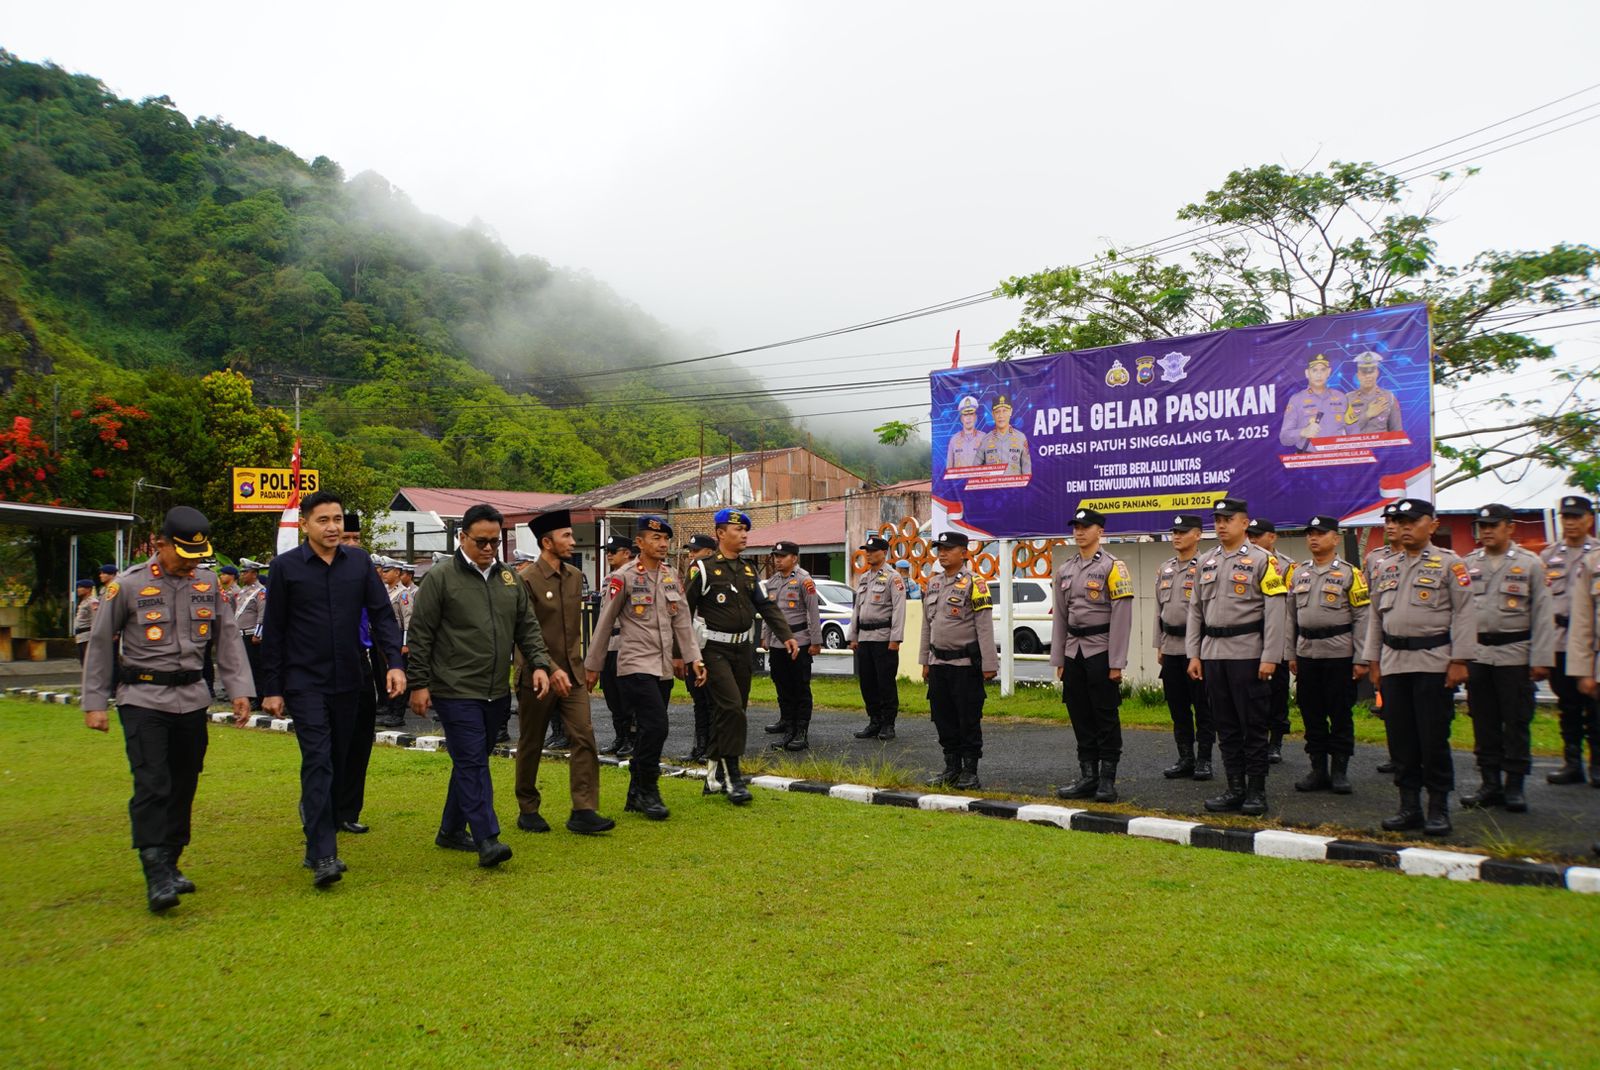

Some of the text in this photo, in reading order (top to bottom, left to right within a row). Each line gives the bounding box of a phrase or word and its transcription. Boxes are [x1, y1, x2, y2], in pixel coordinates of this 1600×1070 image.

[1033, 383, 1276, 436] APEL GELAR PASUKAN
[1038, 425, 1269, 457] OPERASI PATUH SINGGALANG TA. 2025
[1093, 457, 1202, 477] “TERTIB BERLALU LINTAS
[260, 473, 317, 491] POLRES
[1066, 468, 1235, 493] DEMI TERWUJUDNYA INDONESIA EMAS”
[260, 491, 286, 499] PADANG
[1088, 496, 1211, 510] PADANG PANJANG, JULI 2025
[1233, 564, 1254, 572] POLRI
[191, 595, 216, 603] POLRI
